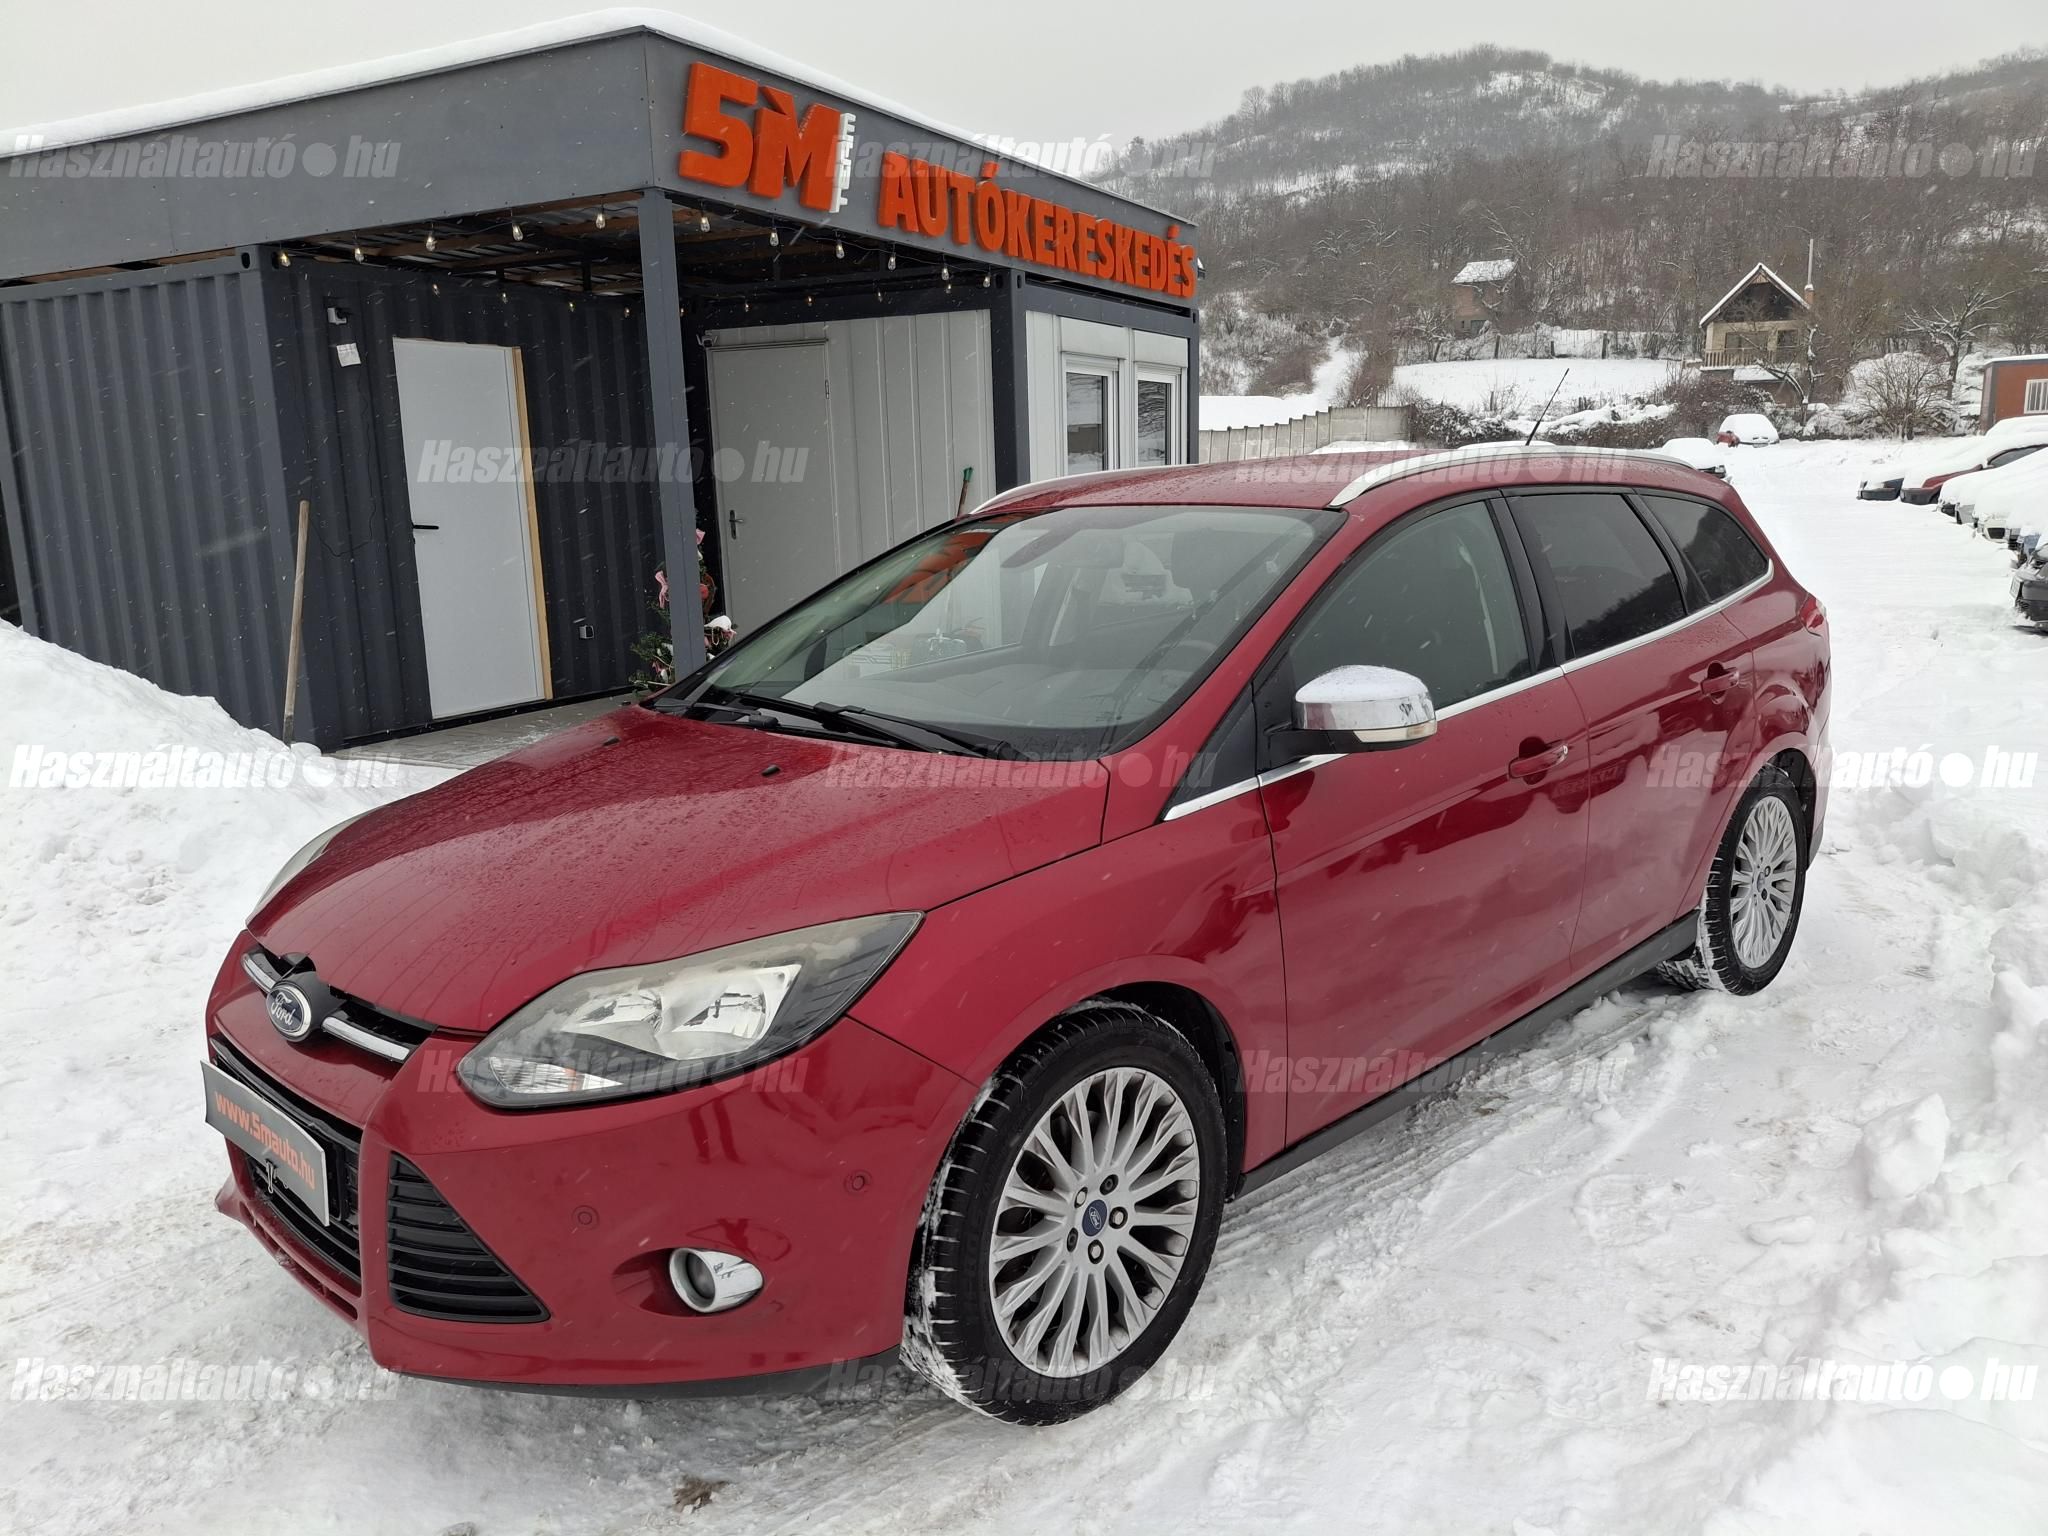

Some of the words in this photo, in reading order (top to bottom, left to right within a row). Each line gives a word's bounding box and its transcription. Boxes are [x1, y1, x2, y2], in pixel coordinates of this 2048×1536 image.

[878, 160, 1199, 299] AUTÓKERESKEDÉS
[269, 992, 295, 1027] Ford
[214, 1091, 316, 1190] www.5mauto.hu
